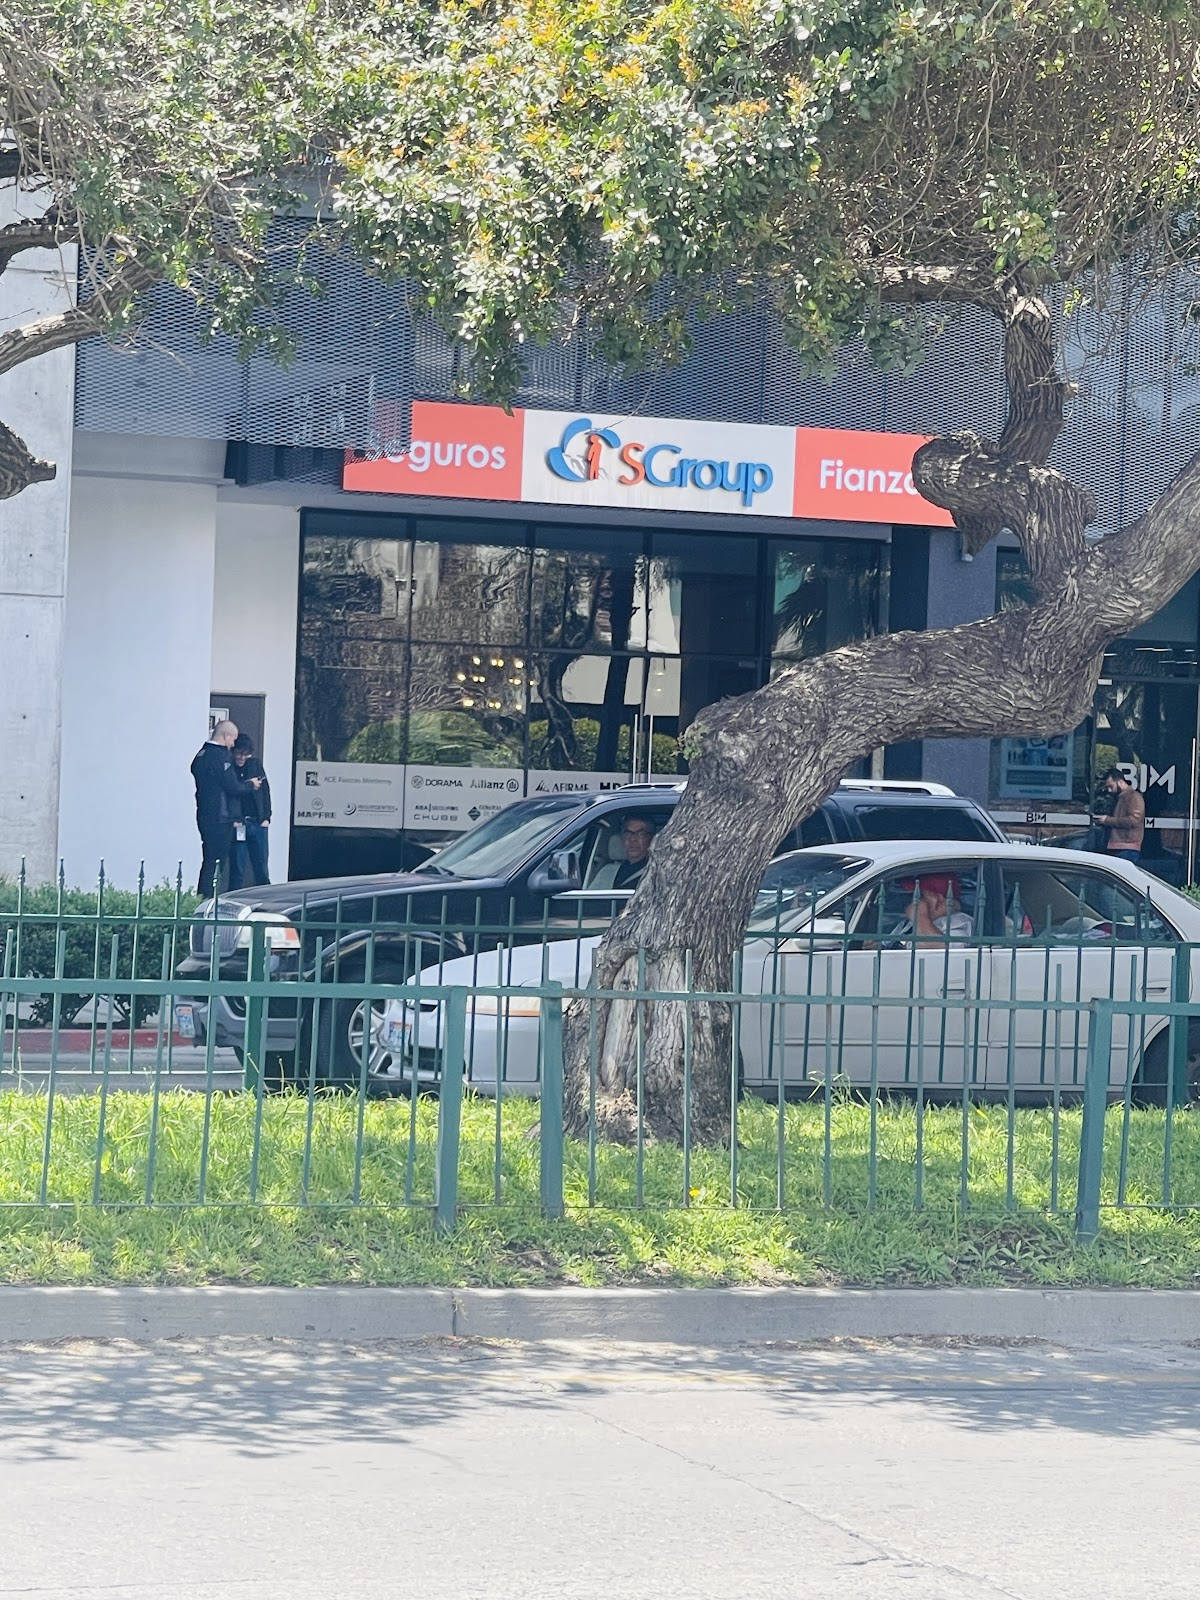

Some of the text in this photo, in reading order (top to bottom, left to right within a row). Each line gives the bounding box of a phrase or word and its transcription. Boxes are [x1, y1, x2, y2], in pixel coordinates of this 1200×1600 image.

[372, 440, 506, 473] guros
[425, 779, 463, 788] DORAMA
[470, 780, 505, 790] Allianz
[297, 811, 336, 819] MAPFRE
[1026, 813, 1046, 822] BIM
